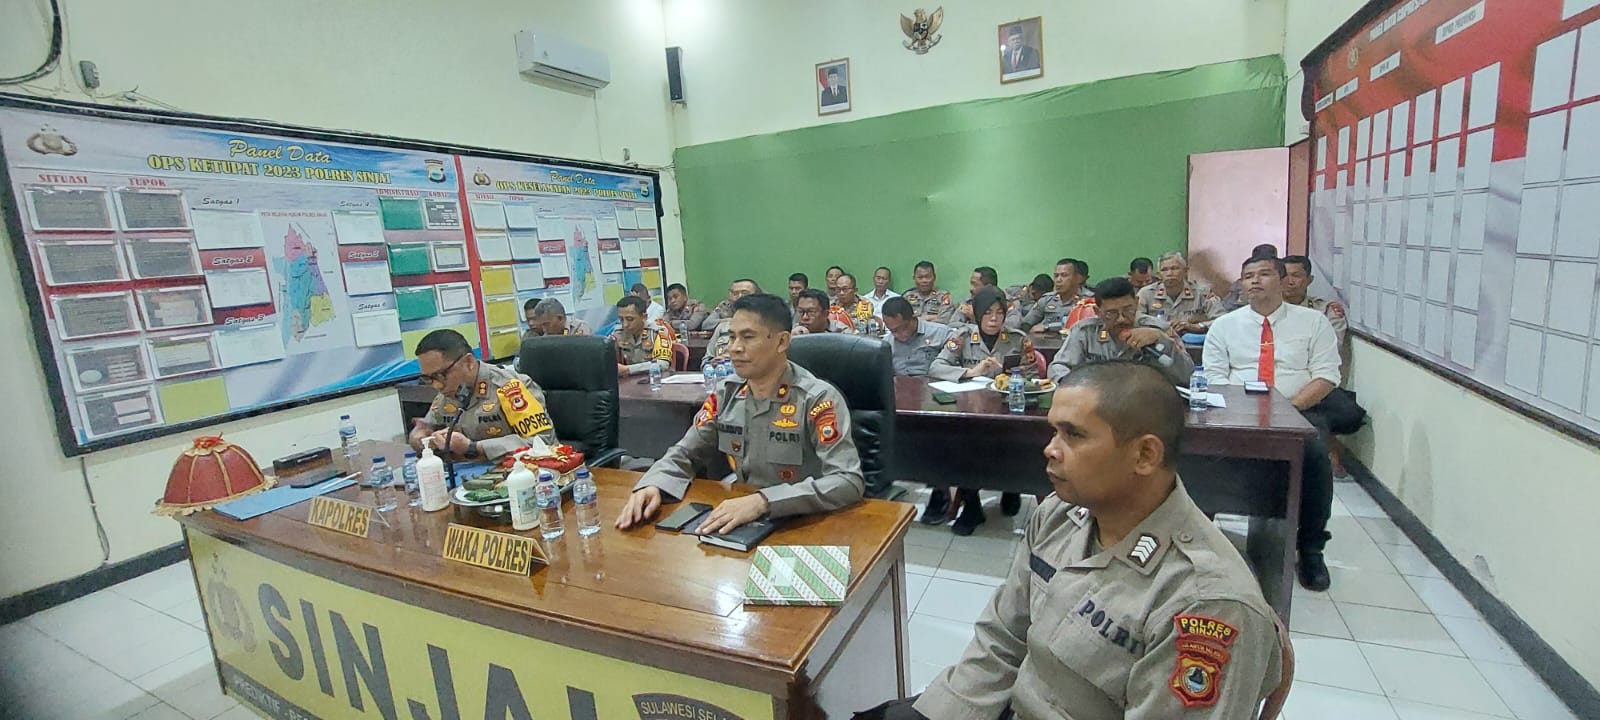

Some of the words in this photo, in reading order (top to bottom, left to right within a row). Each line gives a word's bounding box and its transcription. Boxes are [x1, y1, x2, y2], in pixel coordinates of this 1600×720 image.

[228, 139, 282, 158] Panel
[287, 145, 331, 163] Data
[147, 154, 185, 171] OPS
[188, 158, 259, 176] KETUPAT
[263, 164, 301, 178] 2023
[305, 167, 354, 182] POLRES
[356, 170, 392, 184] SINJAI
[38, 174, 89, 184] SITUASI
[128, 177, 167, 187] TUPOK
[202, 197, 233, 206] Satgas
[213, 257, 243, 266] Satgas
[224, 316, 255, 326] Satgas
[518, 415, 539, 435] OPS
[769, 430, 800, 443] POLRI
[311, 498, 370, 536] KAPOLRES
[445, 526, 480, 565] WAKA
[479, 533, 529, 572] POLRES
[1078, 599, 1141, 655] POLRI
[1181, 617, 1232, 636] POLRES
[1188, 626, 1224, 640] SINJAI
[258, 582, 598, 720] SINJ
[640, 701, 696, 719] SULAWESI
